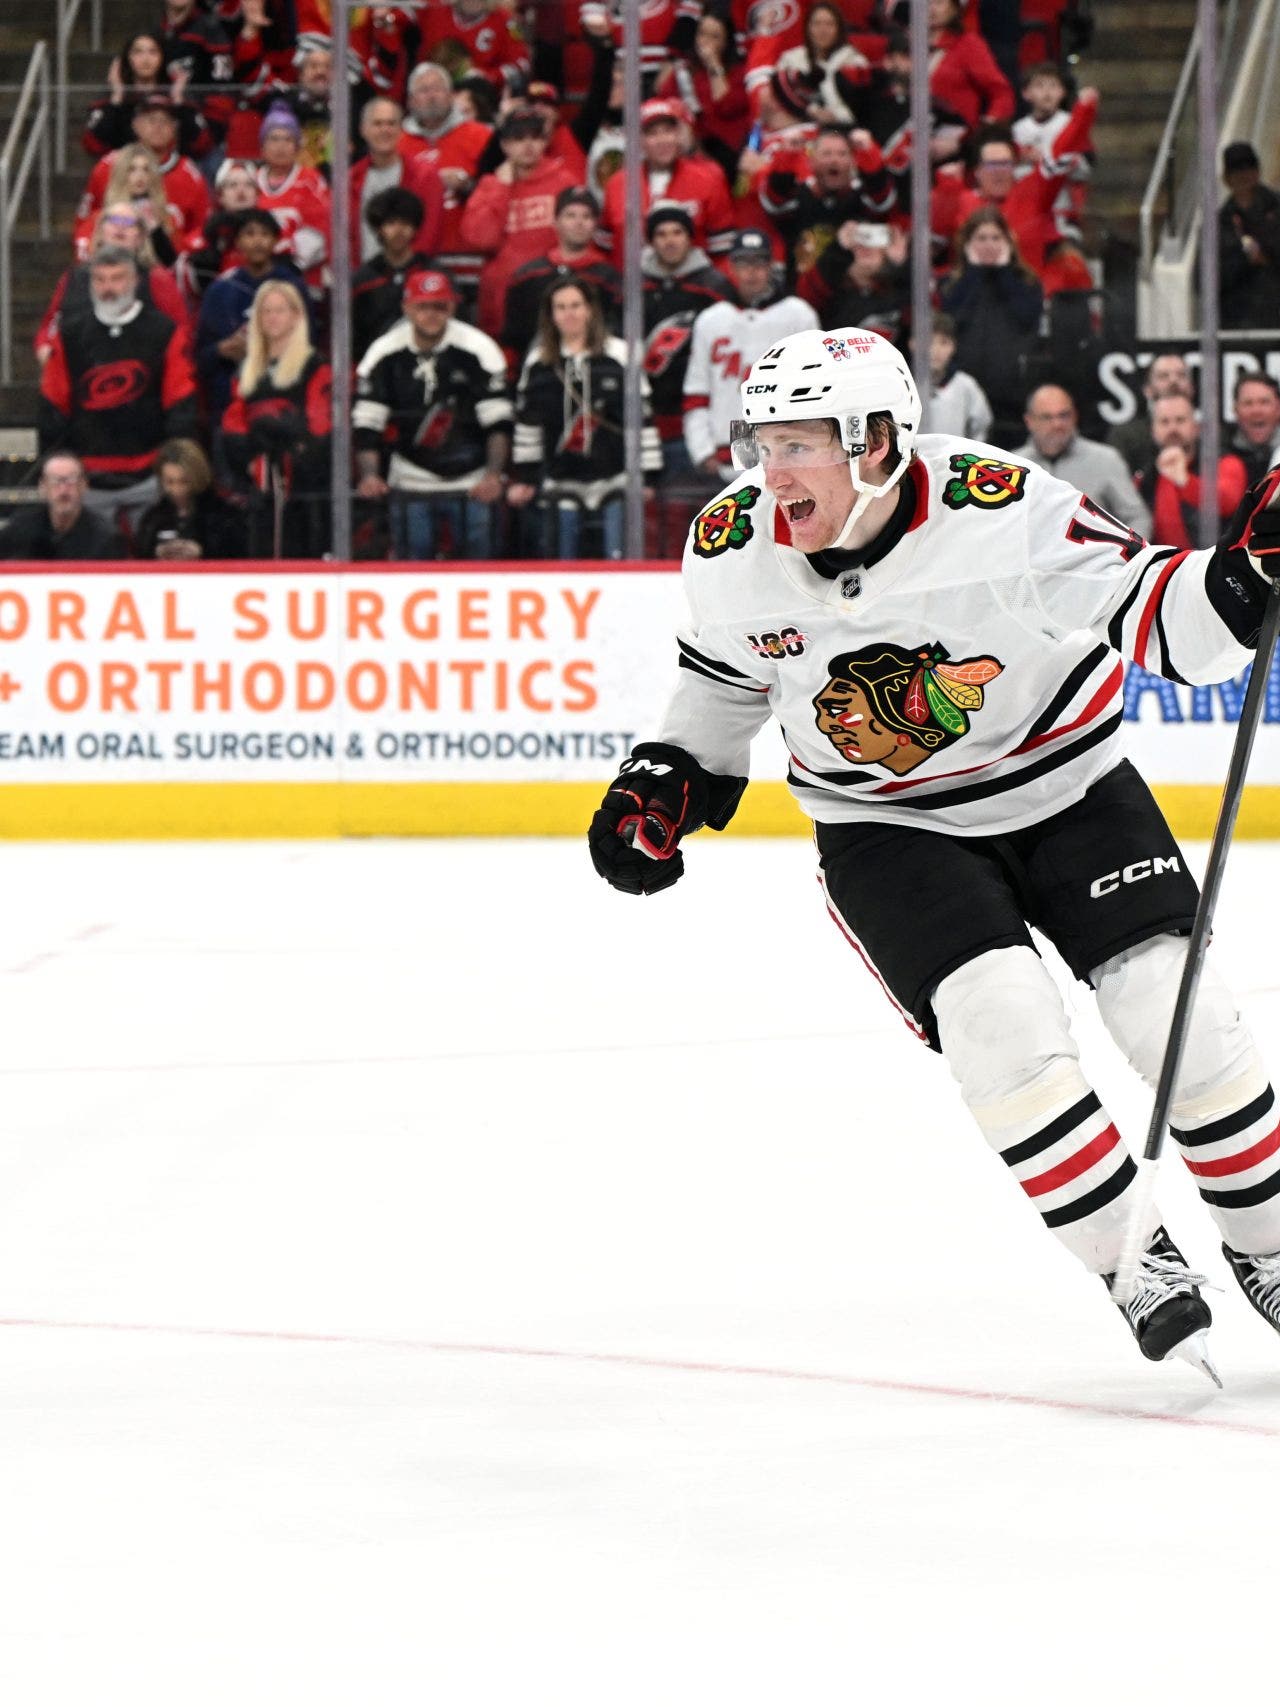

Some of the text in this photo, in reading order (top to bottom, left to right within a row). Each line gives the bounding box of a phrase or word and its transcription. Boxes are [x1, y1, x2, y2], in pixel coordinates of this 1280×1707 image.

[746, 384, 778, 395] CCM
[0, 590, 601, 641] ORAL SURGERY
[47, 660, 599, 713] ORTHODONTICS
[77, 732, 162, 760] ORAL
[175, 732, 334, 760] SURGEON
[345, 733, 364, 760] &
[376, 732, 635, 760] ORTHODONTIST
[1090, 856, 1181, 899] CCM
